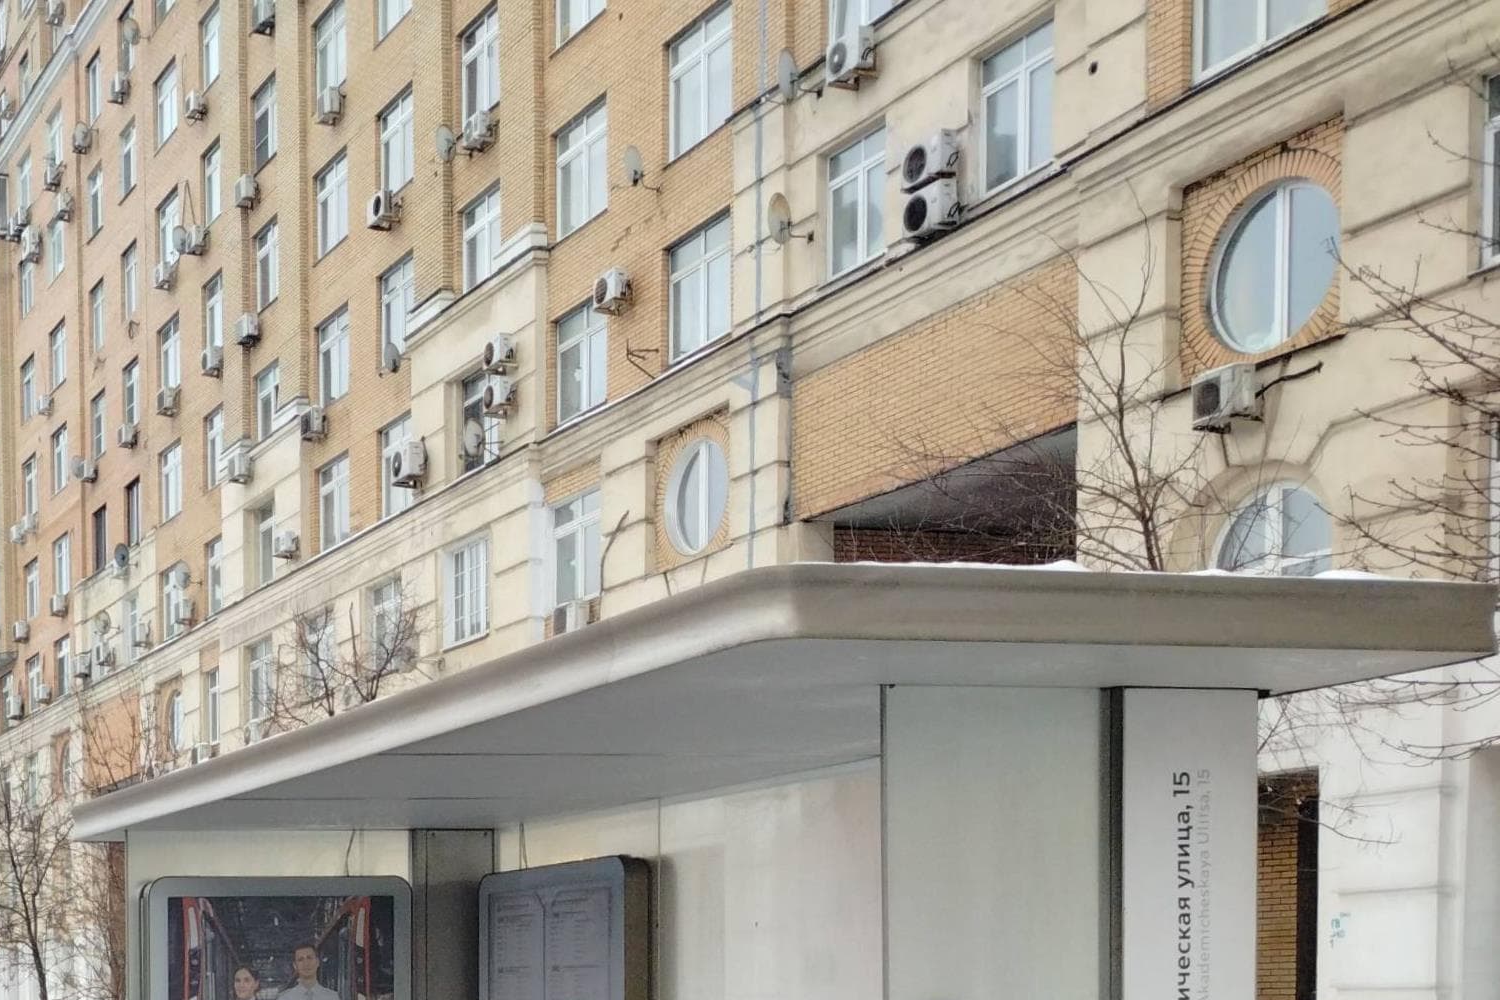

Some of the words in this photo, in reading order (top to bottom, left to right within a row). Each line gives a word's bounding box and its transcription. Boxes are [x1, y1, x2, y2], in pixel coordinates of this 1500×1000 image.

[1172, 771, 1191, 797] 15
[1196, 768, 1211, 786] 15
[1176, 804, 1195, 888] улица,
